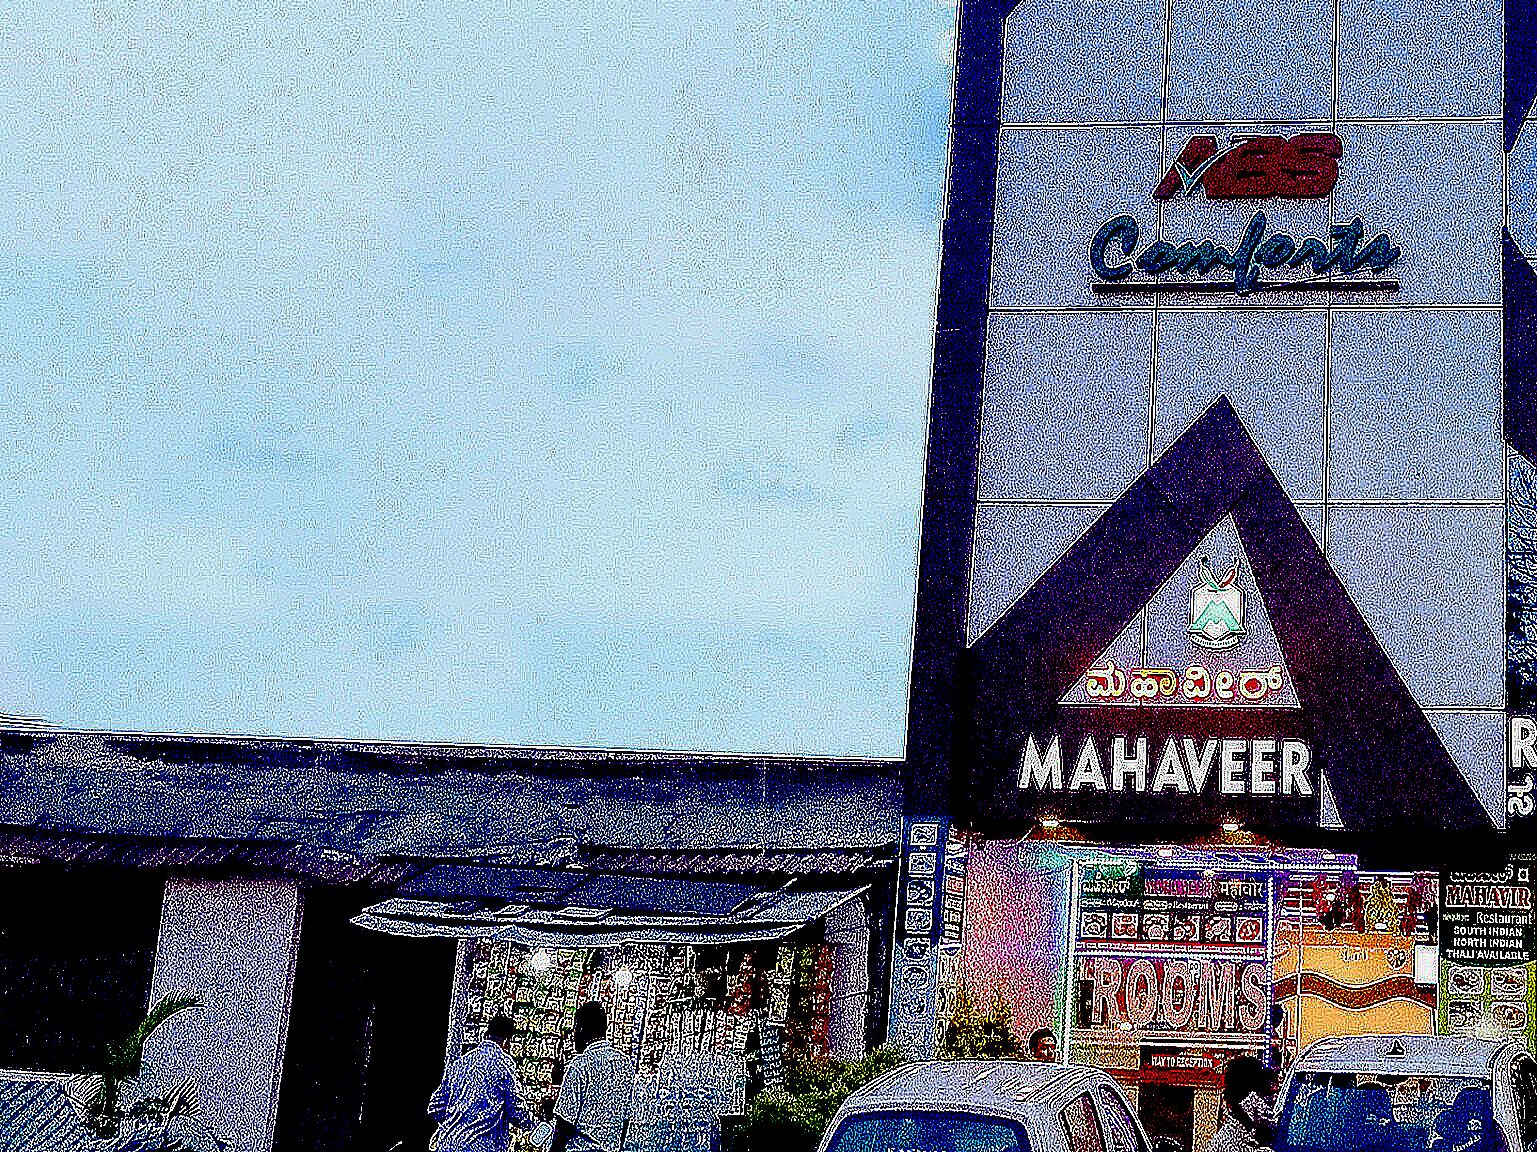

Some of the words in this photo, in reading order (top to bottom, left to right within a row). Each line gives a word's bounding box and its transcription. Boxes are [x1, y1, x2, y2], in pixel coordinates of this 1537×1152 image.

[1090, 210, 1402, 296] Comforts
[1018, 731, 1314, 798] MAHAVEER
[1445, 884, 1532, 910] MAHAVIR
[1475, 911, 1533, 925] Restaurant
[1453, 925, 1487, 936] SOUTH
[1489, 926, 1523, 937] INDIAN
[1453, 937, 1487, 948] NORTH
[1489, 938, 1523, 949] INDIAN
[1477, 950, 1530, 961] AVAILABLE
[1091, 959, 1268, 1030] ROOMS
